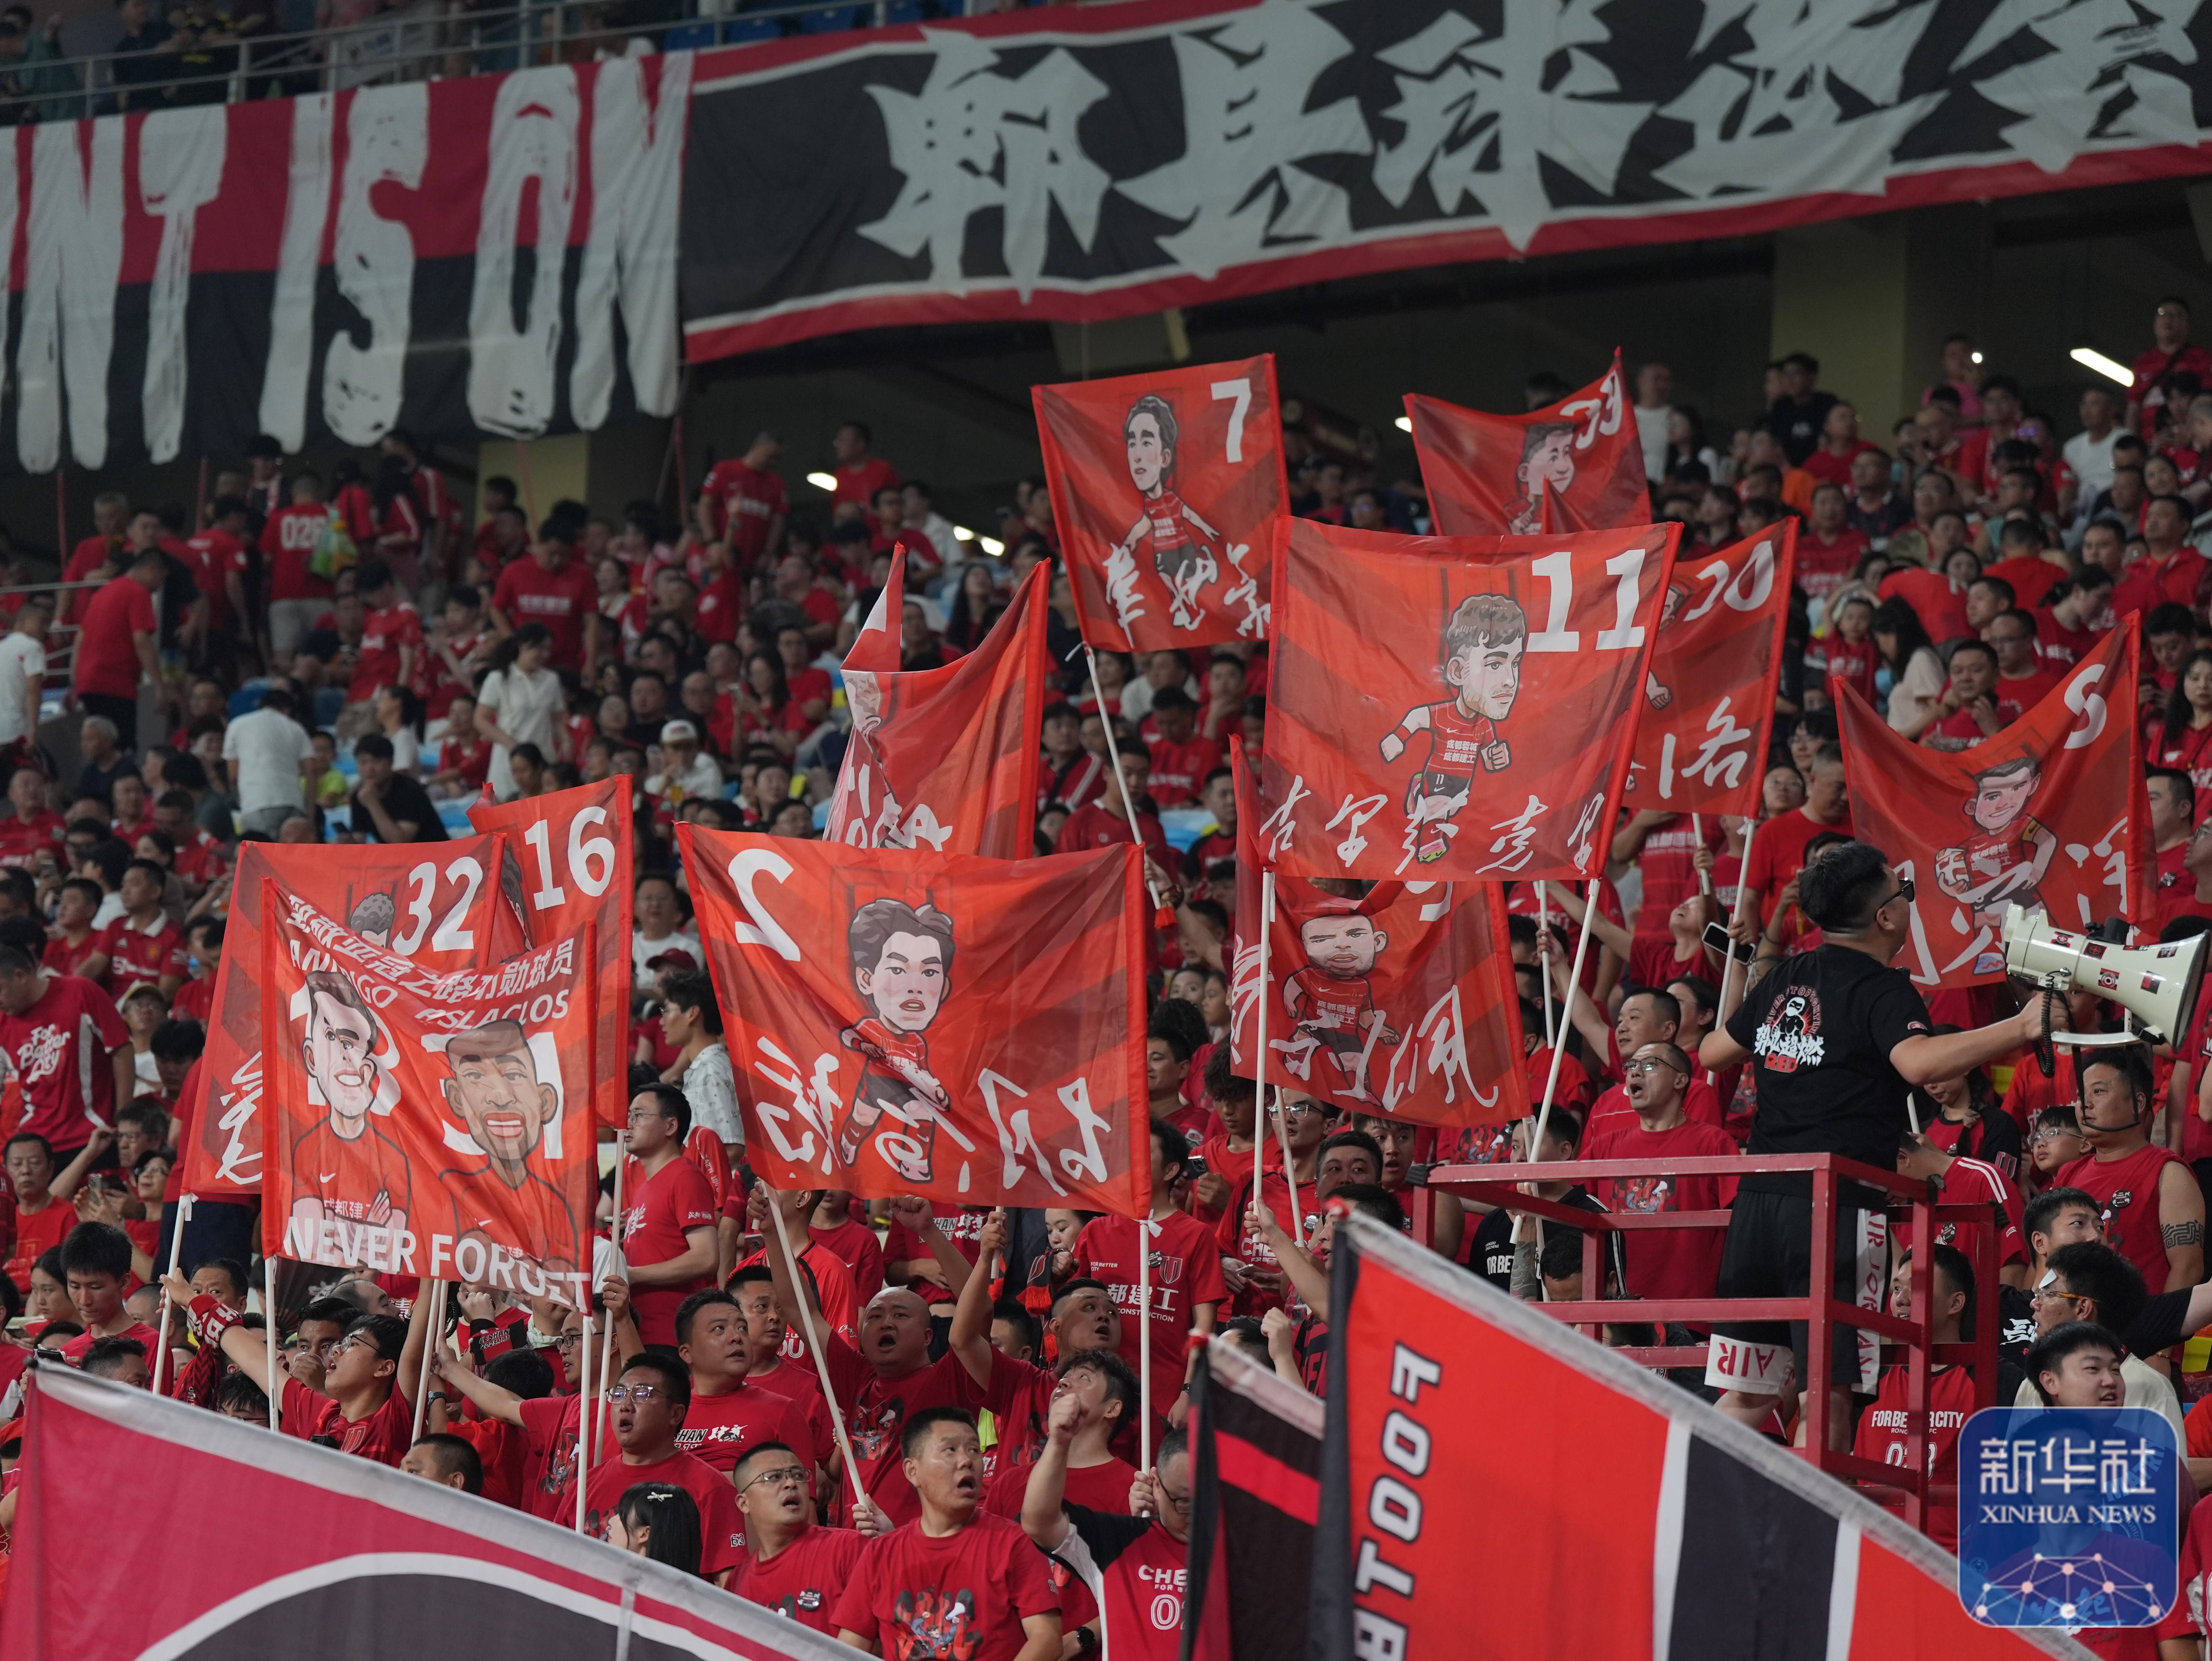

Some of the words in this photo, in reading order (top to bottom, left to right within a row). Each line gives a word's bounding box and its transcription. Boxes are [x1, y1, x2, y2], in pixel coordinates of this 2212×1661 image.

[0, 105, 227, 473] NT
[259, 82, 429, 453] IS
[467, 50, 695, 439] ON
[1210, 378, 1252, 463] 7
[1527, 549, 1646, 652] 11
[1443, 752, 1475, 764] 成都建工
[1447, 739, 1478, 752] 成都蓉城
[1436, 774, 1444, 785] 11
[524, 806, 617, 911] 16
[393, 856, 483, 956] 32
[1764, 1053, 1798, 1073] RED
[323, 1198, 372, 1220] 成都建
[283, 1216, 416, 1274] NEVER
[430, 1233, 592, 1315] FORGET
[1717, 1342, 1776, 1378] AIR
